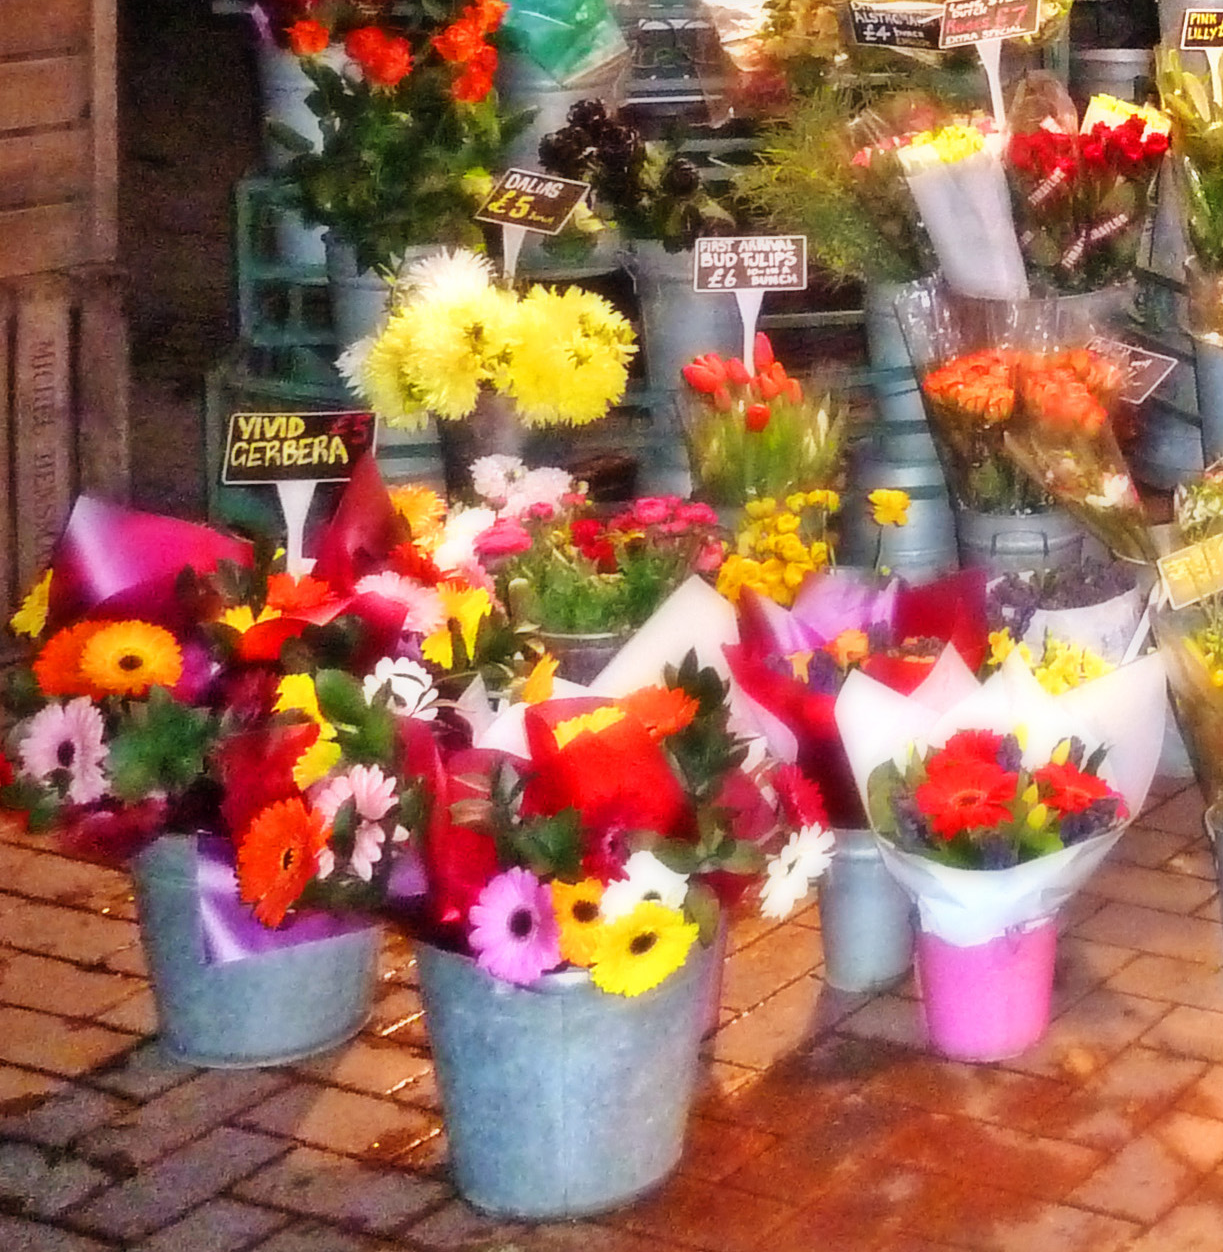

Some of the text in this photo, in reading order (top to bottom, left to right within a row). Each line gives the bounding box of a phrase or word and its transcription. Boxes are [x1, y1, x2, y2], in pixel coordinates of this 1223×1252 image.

[1190, 13, 1217, 25] PINK
[862, 25, 891, 42] £4
[487, 189, 535, 219] £5
[700, 251, 798, 268] BUD TULIPS
[707, 268, 738, 288] £6
[238, 415, 306, 441] VIVID
[231, 434, 349, 468] GERBERA
